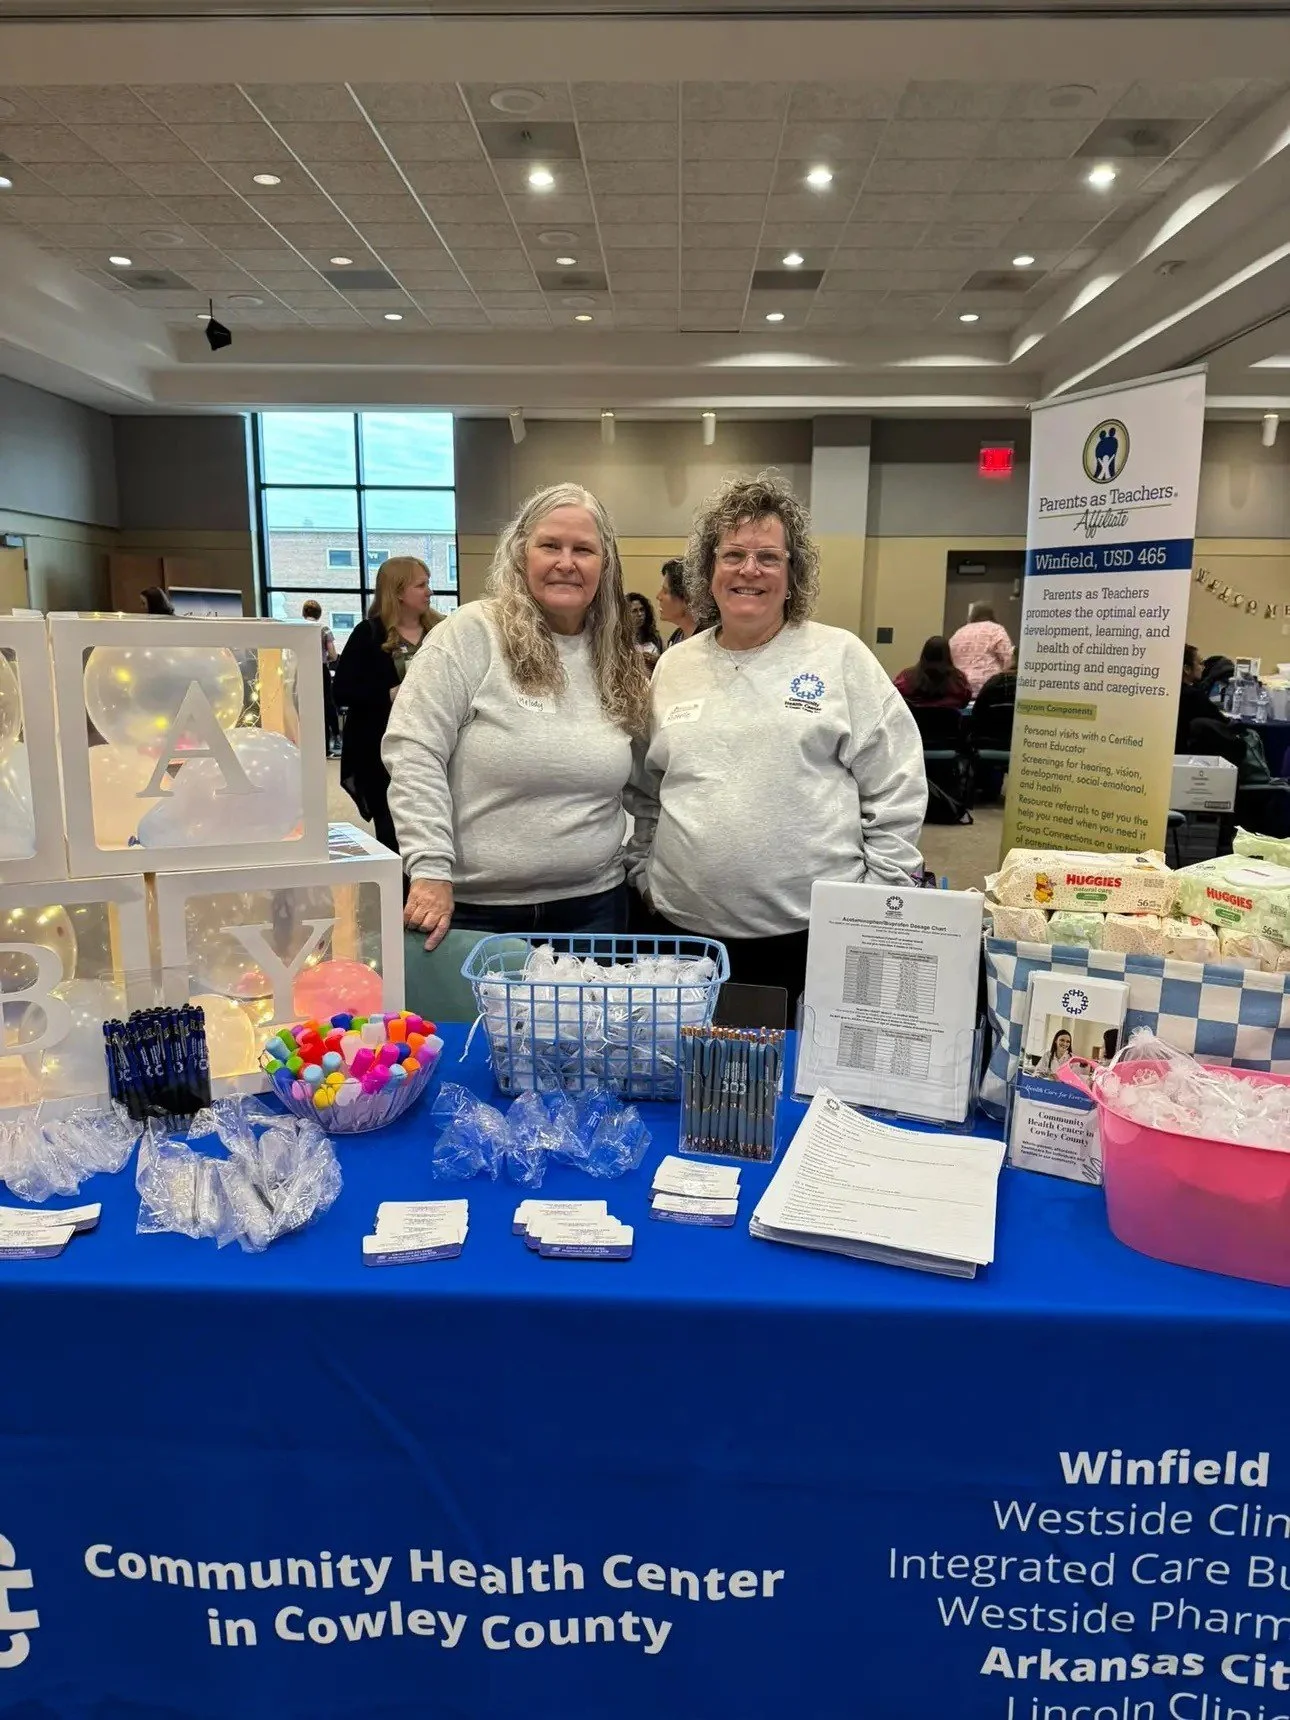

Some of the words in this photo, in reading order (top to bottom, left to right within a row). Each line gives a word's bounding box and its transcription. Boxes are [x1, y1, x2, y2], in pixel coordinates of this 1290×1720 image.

[1039, 494, 1087, 512] Parents
[1091, 494, 1106, 507] as
[1073, 508, 1128, 538] Affiliate
[1035, 552, 1098, 570] Winfield,
[1104, 549, 1134, 566] USD
[1138, 547, 1167, 565] 465
[1043, 589, 1082, 600] Parents
[1085, 590, 1098, 599] as
[1102, 587, 1149, 599] Teachers
[1026, 608, 1072, 620] promotes
[1075, 607, 1093, 618] the
[1097, 606, 1136, 620] optimal
[1139, 606, 1170, 620] early
[1024, 625, 1092, 638] development,
[1095, 625, 1142, 639] learning,
[1146, 626, 1170, 638] and
[1036, 642, 1069, 654] health
[1073, 643, 1084, 654] of
[1086, 643, 1129, 656] children
[1132, 645, 1147, 658] by
[1024, 660, 1081, 674] supporting
[1084, 662, 1104, 673] and
[1107, 664, 1160, 679] engaging
[1038, 680, 1080, 691] parents
[1083, 681, 1104, 692] and
[1106, 684, 1169, 697] caregivers.
[1047, 704, 1093, 716] Components
[1023, 738, 1048, 749] Parent
[1050, 740, 1086, 753] Educator
[1024, 725, 1057, 737] Personal
[1060, 728, 1079, 739] visits
[1081, 731, 1099, 742] with
[1108, 733, 1144, 747] Certified
[1022, 753, 1064, 768] Screenings
[1066, 758, 1078, 769] for
[1081, 761, 1113, 776] hearing,
[1116, 766, 1142, 780] vision,
[1020, 780, 1034, 789] and
[1036, 782, 1062, 794] health
[1021, 767, 1074, 783] development,
[1077, 776, 1147, 796] social-emotional,
[1018, 794, 1053, 808] Resource
[1055, 800, 1089, 814] referrals
[1091, 808, 1099, 816] to
[1101, 810, 1114, 820] get
[1116, 813, 1131, 824] you
[1134, 814, 1148, 826] the
[1018, 807, 1034, 819] help
[1035, 811, 1050, 821] you
[1053, 814, 1074, 825] need
[1076, 818, 1098, 830] when
[1099, 823, 1114, 833] you
[1116, 826, 1138, 838] need
[1140, 830, 1147, 840] it
[1016, 821, 1041, 834] Group
[1043, 826, 1093, 845] Connections
[1095, 839, 1105, 848] on
[1107, 842, 1113, 850] a
[1016, 834, 1023, 844] of
[1066, 874, 1122, 888] HUGGIES
[1137, 899, 1149, 907] 56
[1206, 887, 1253, 910] HUGGIES
[1262, 925, 1272, 935] 56
[1028, 1117, 1054, 1129] Health
[1056, 1124, 1084, 1136] Center
[1086, 1129, 1095, 1138] in
[1038, 1111, 1084, 1128] Community
[1030, 1127, 1058, 1140] Cowley
[1060, 1133, 1089, 1147] County
[1059, 1448, 1270, 1488] Winfield
[992, 1500, 1193, 1536] Westside
[84, 1543, 392, 1596] Community
[409, 1549, 585, 1595] Health
[602, 1554, 785, 1602] Center
[889, 1547, 1115, 1588] Integrated
[1131, 1552, 1231, 1585] Care
[937, 1595, 1136, 1634] Westside
[207, 1608, 257, 1647] in
[274, 1600, 468, 1649] Cowley
[481, 1611, 673, 1655] County
[980, 1645, 1205, 1683] Arkansas
